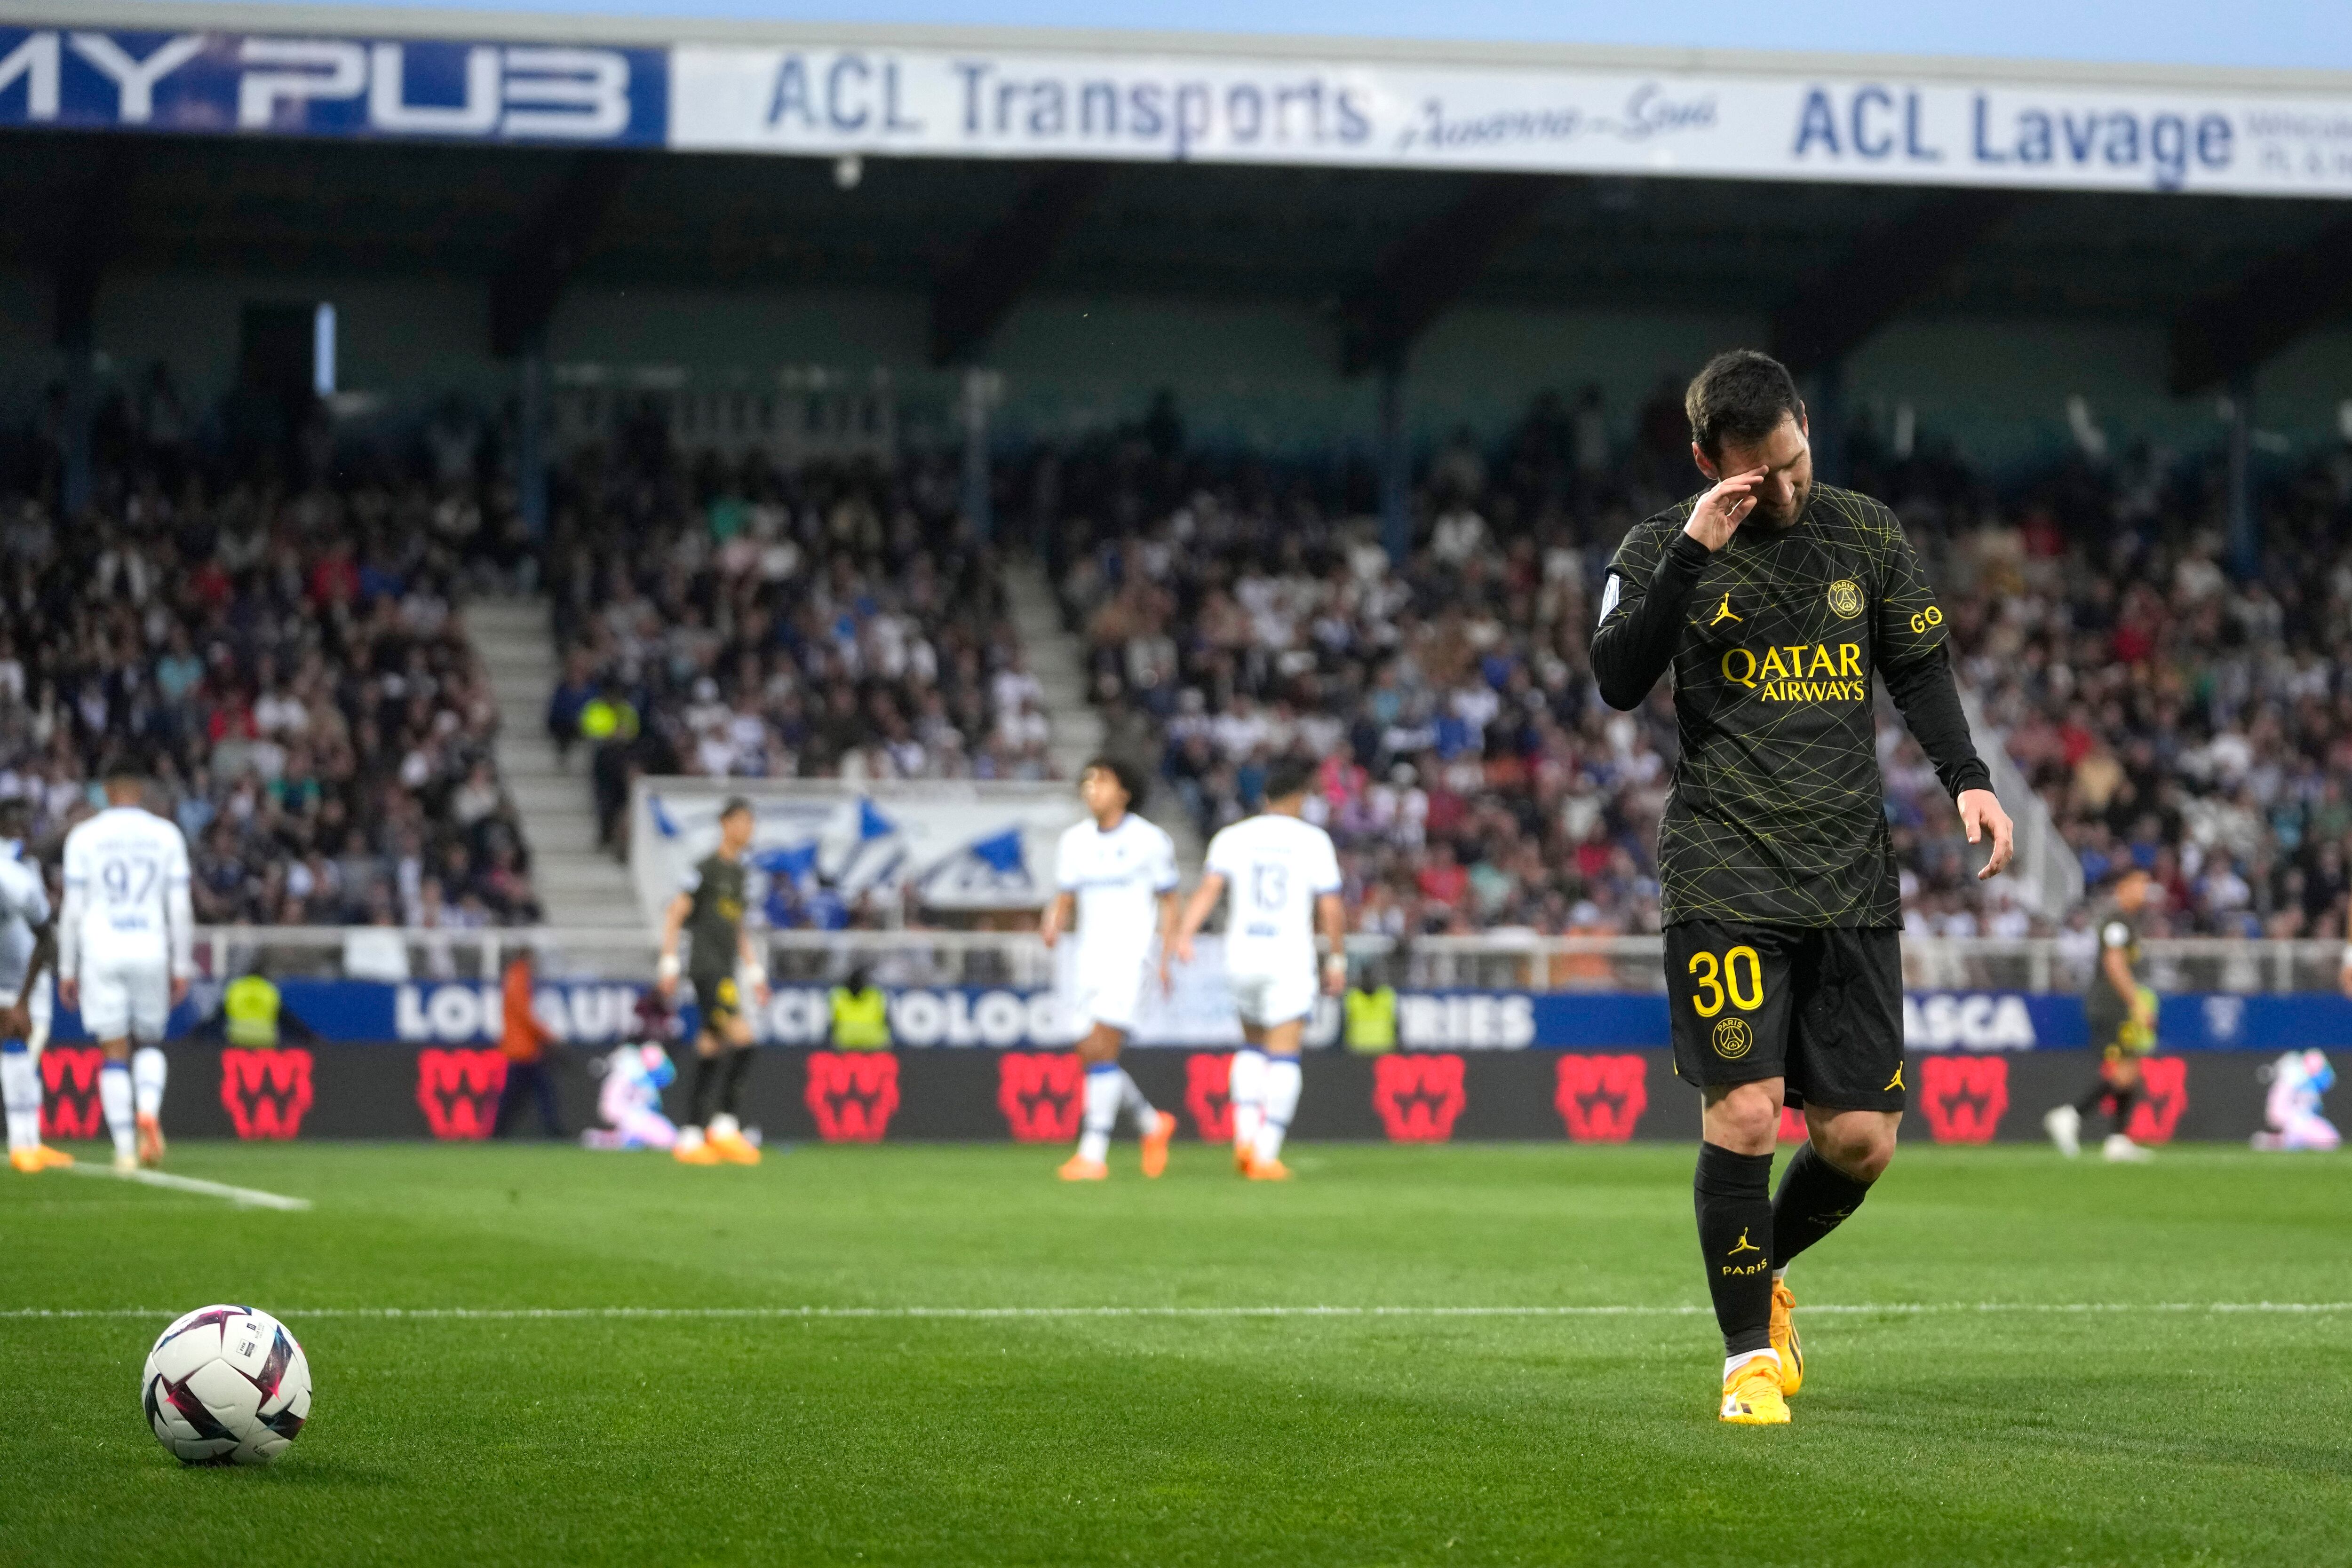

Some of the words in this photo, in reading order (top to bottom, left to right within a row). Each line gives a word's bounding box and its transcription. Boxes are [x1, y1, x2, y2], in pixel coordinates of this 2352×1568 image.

[766, 55, 923, 133] ACL
[951, 60, 1373, 160] Transports
[1793, 86, 1947, 160] ACL
[1972, 93, 2233, 189] Lavage
[1832, 582, 1855, 592] PARIS
[1911, 606, 1942, 634] GO
[1722, 643, 1863, 689] QATAR
[1761, 681, 1865, 701] AIRWAYS
[102, 856, 157, 904] 97
[1251, 861, 1289, 911] 13
[1689, 946, 1764, 1017] 30
[1717, 1020, 1743, 1031] PARIS
[1723, 1258, 1767, 1275] PARIS
